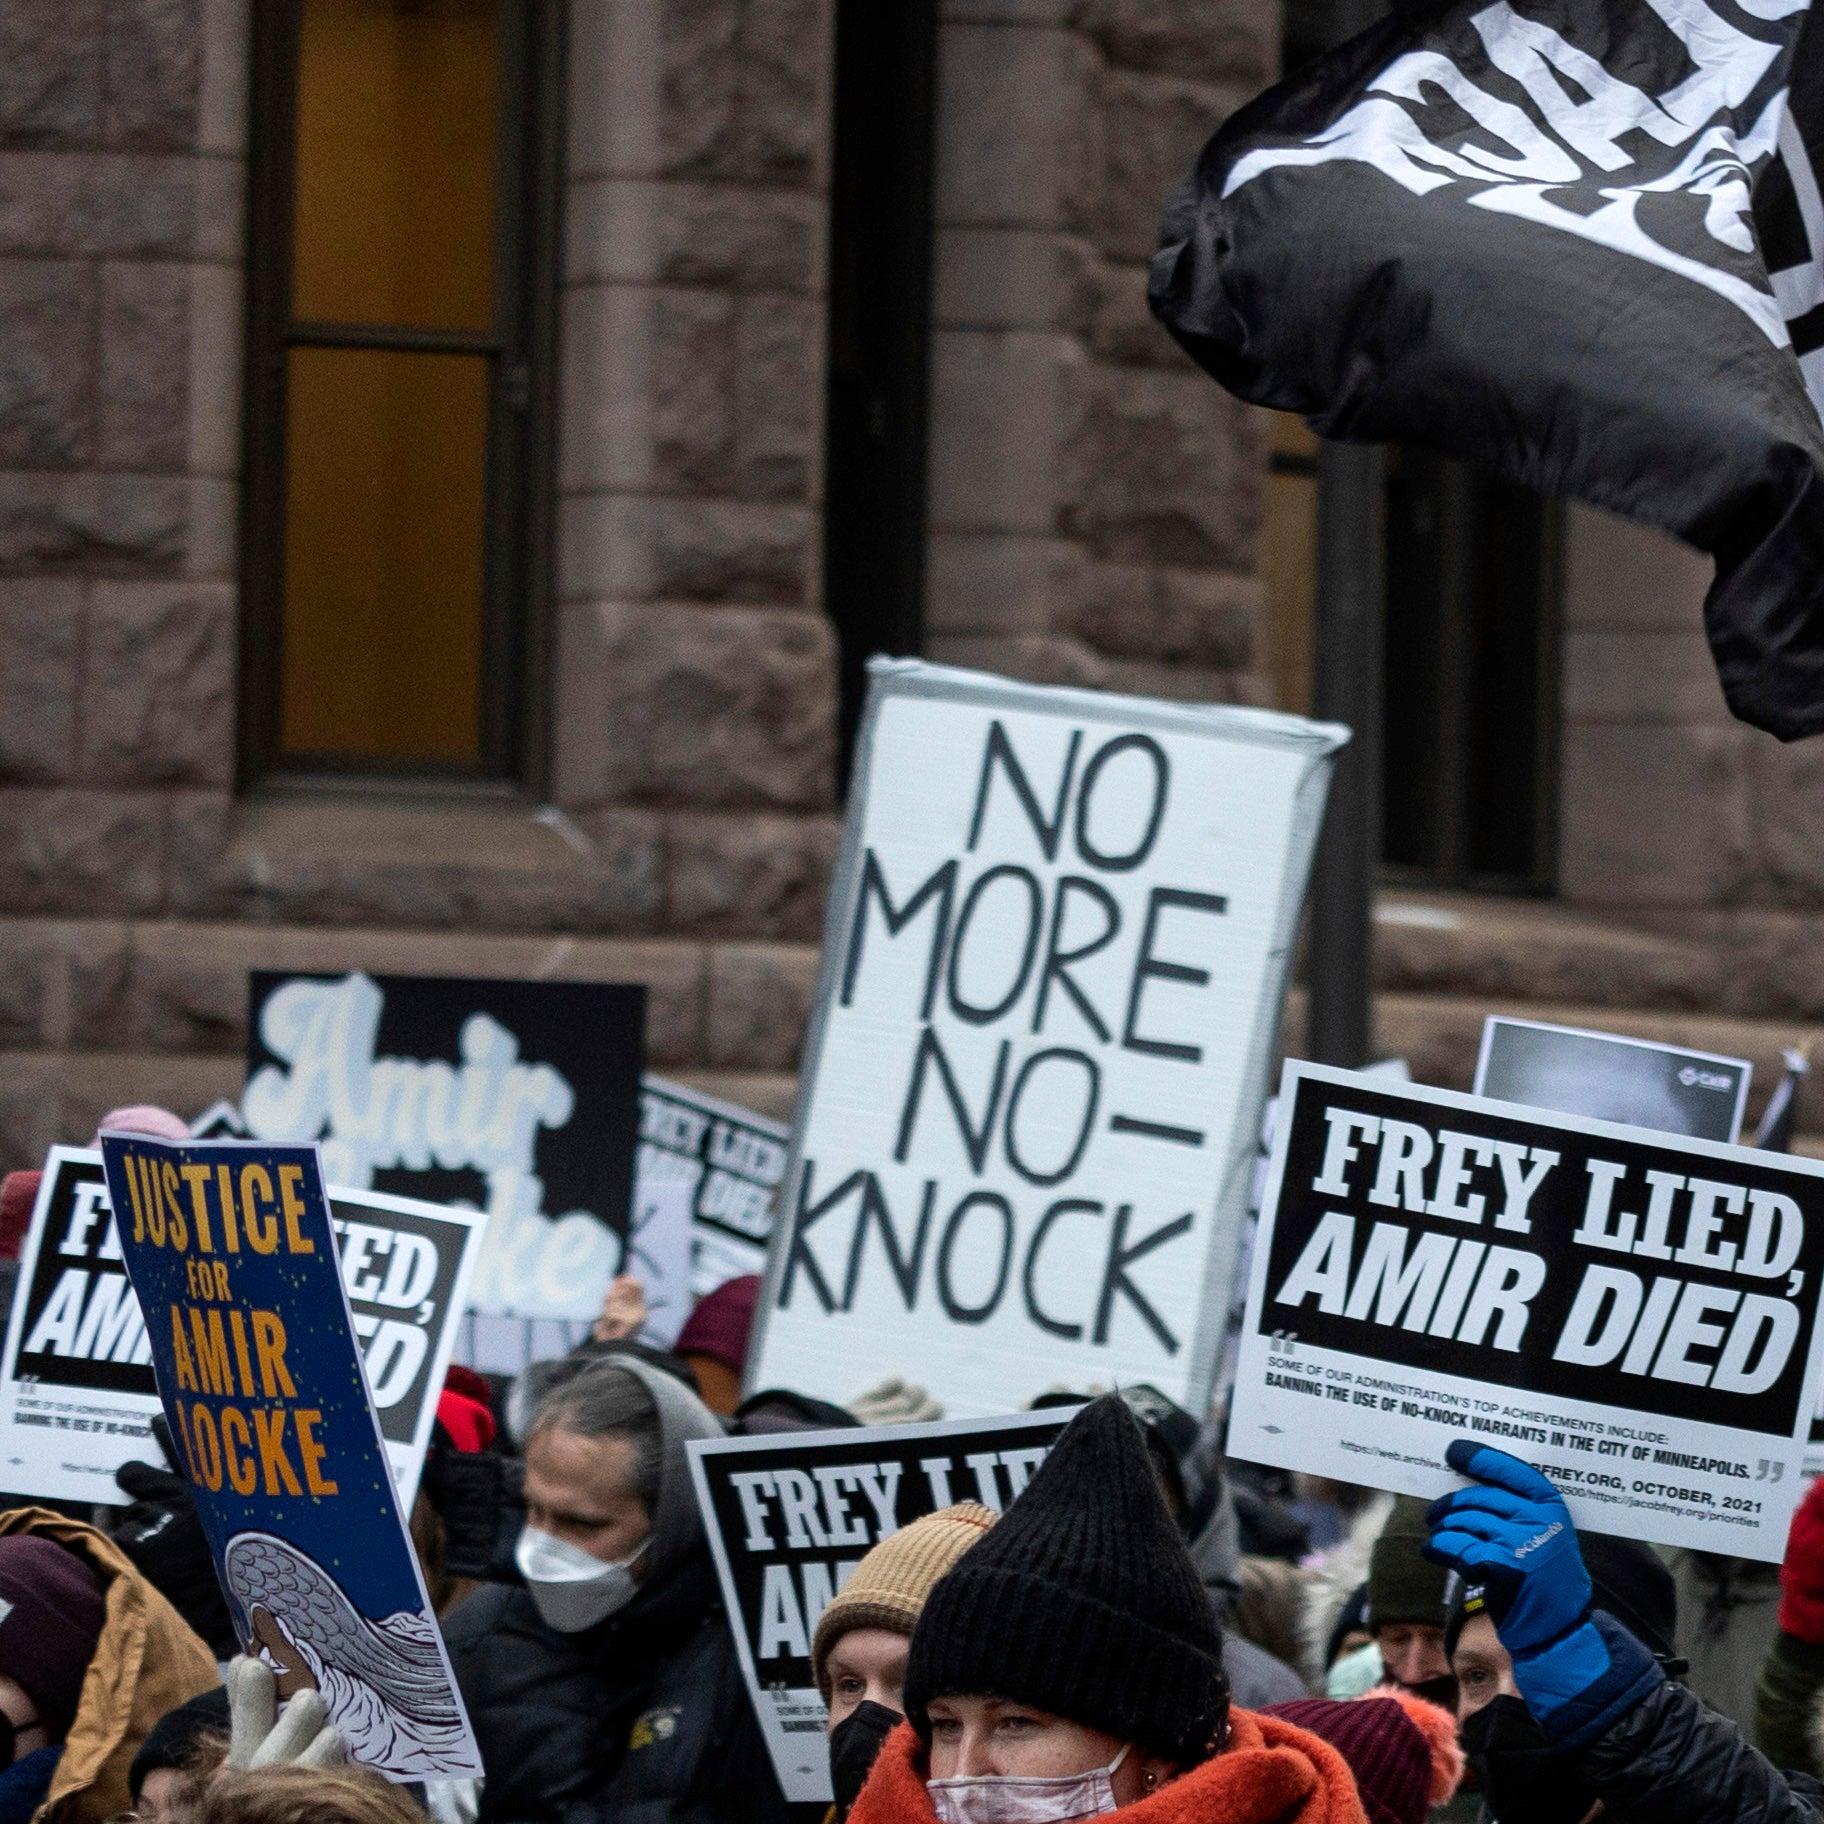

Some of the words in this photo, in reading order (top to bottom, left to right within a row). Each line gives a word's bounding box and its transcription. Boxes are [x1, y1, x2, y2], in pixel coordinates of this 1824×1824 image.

[967, 720, 1170, 871] NO
[839, 848, 1228, 1062] MORE
[243, 970, 575, 1171] Amir
[894, 1026, 1204, 1188] NO-
[123, 1155, 316, 1255] JUSTICE
[1312, 1106, 1562, 1235] FREY
[1573, 1159, 1806, 1298] LIED,
[187, 1260, 233, 1302] FOR
[778, 1159, 1194, 1358] KNOCK
[1274, 1212, 1549, 1354] AMIR
[1552, 1263, 1803, 1397] DIED
[171, 1305, 298, 1399] AMIR
[1268, 1356, 1303, 1373] SOME
[1306, 1363, 1324, 1377] OF
[1325, 1368, 1352, 1383] OUR
[1355, 1374, 1471, 1409] ADMINISTRATION'S
[1473, 1399, 1500, 1414] TOP
[1502, 1406, 1605, 1434] ACHIEVEMENTS
[1607, 1424, 1671, 1446] INCLUDE:
[176, 1400, 340, 1497] LOCKE
[1265, 1372, 1323, 1397] BANNING
[1326, 1384, 1350, 1402] THE
[1353, 1390, 1378, 1409] USE
[1380, 1396, 1399, 1412] OF
[1401, 1401, 1469, 1429] NO-KNOCK
[1471, 1416, 1547, 1444] WARRANTS
[1550, 1431, 1566, 1446] IN
[1569, 1434, 1596, 1452] THE
[1597, 1440, 1630, 1458] CITY
[1631, 1445, 1652, 1462] OF
[1653, 1450, 1751, 1480] MINNEAPOLIS.
[730, 1461, 903, 1553] FREY
[1632, 1480, 1717, 1508] OCTOBER,
[1722, 1495, 1763, 1515] 2021
